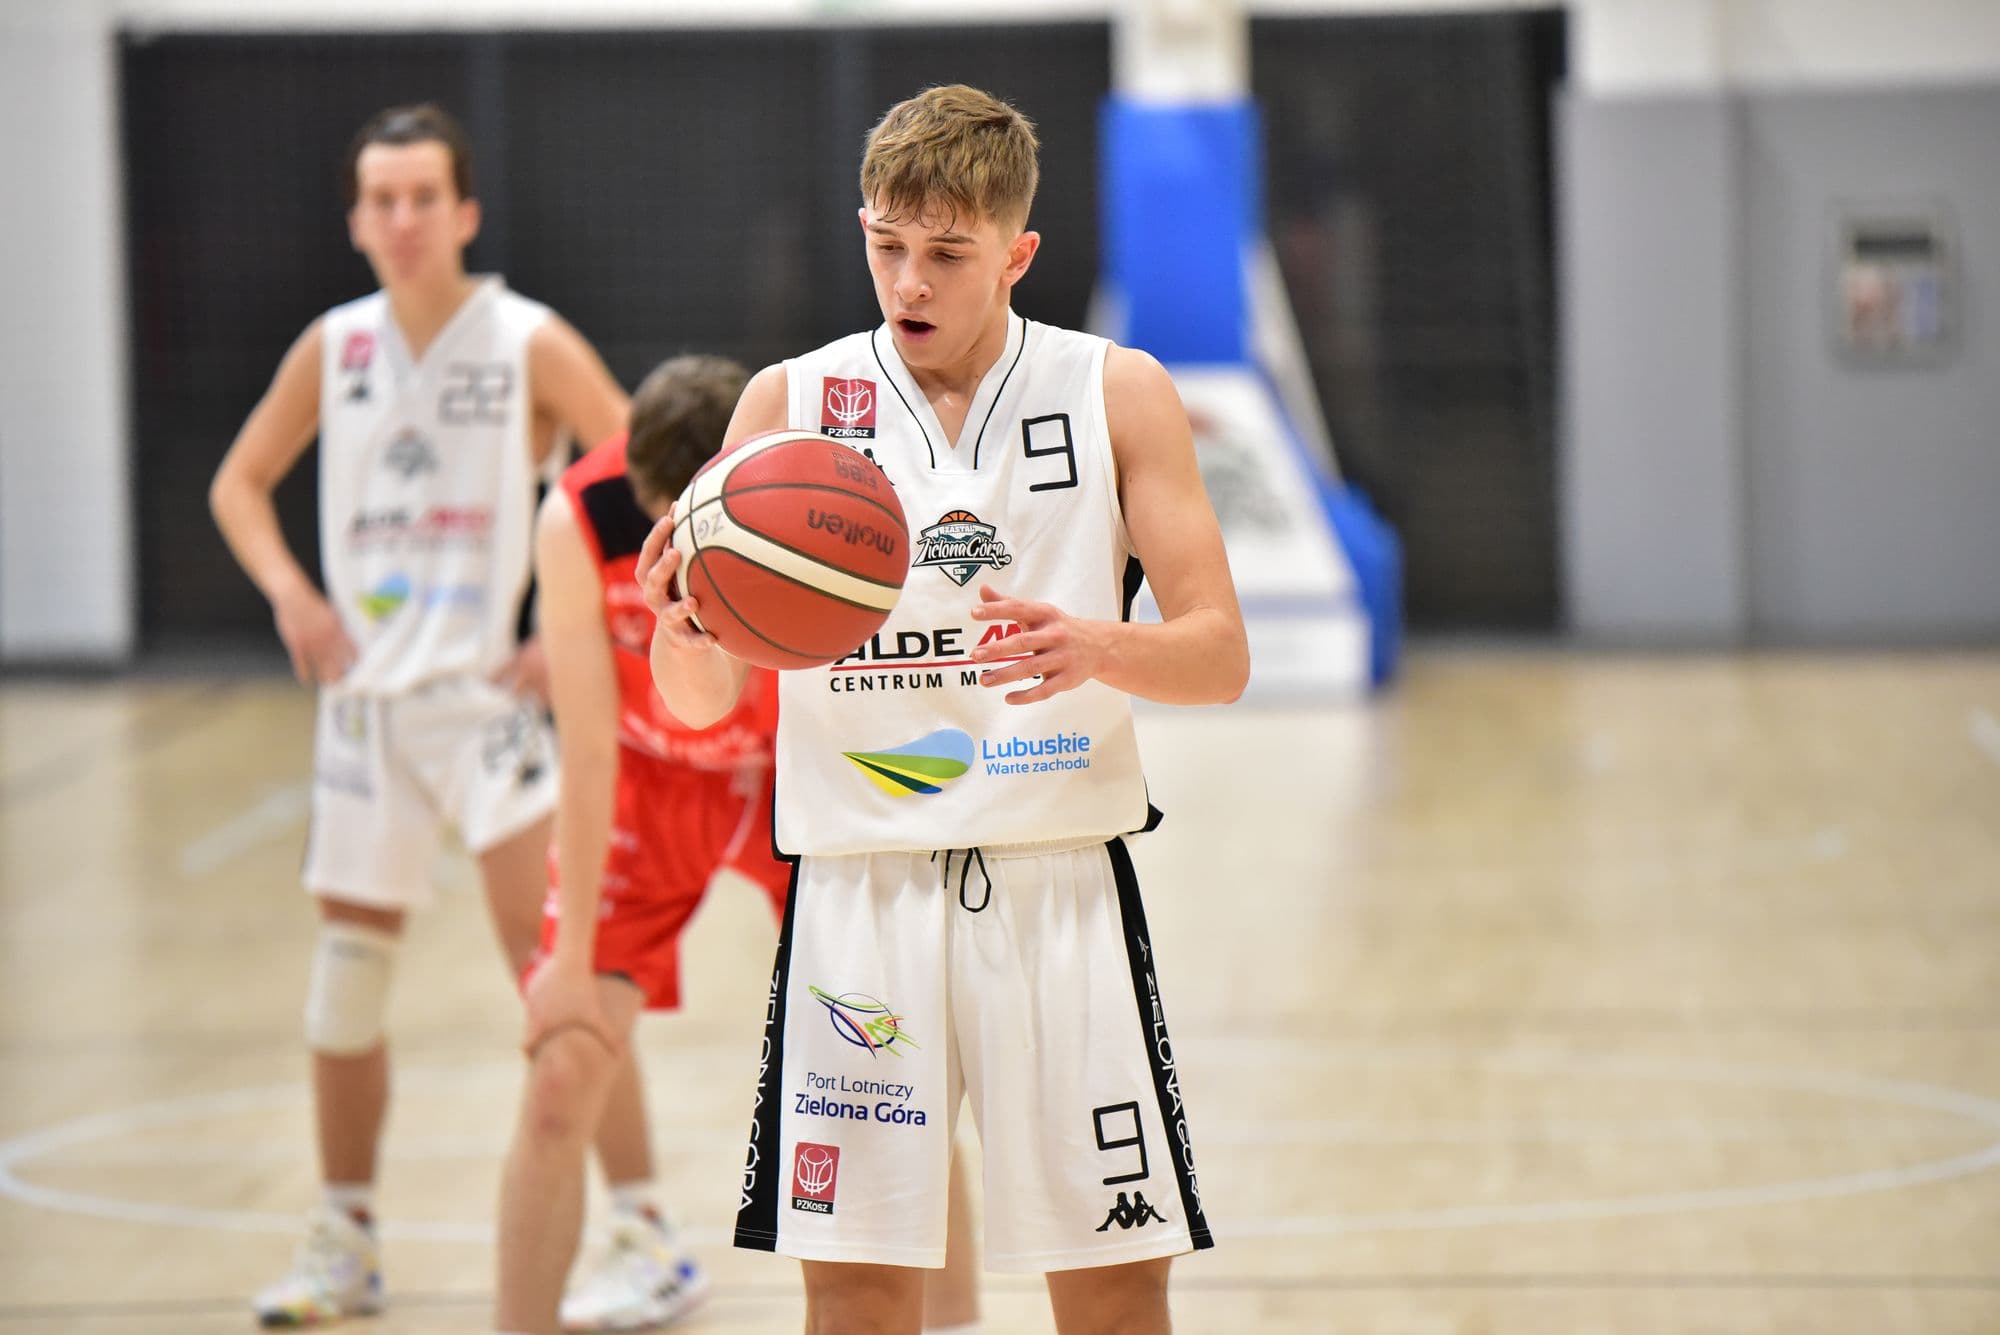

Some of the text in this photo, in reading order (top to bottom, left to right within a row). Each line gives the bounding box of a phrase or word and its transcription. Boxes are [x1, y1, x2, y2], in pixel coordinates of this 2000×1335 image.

[1022, 413, 1078, 492] 9
[807, 508, 896, 557] molten
[830, 673, 943, 692] CENTRUM
[982, 732, 1090, 760] Lubuskie
[986, 756, 1090, 775] Warte zachodu
[1146, 972, 1184, 1116] ZIELONA
[807, 1072, 914, 1101] Port Lotniczy
[795, 1093, 926, 1126] Zielona Góra
[1092, 1101, 1149, 1185] 9
